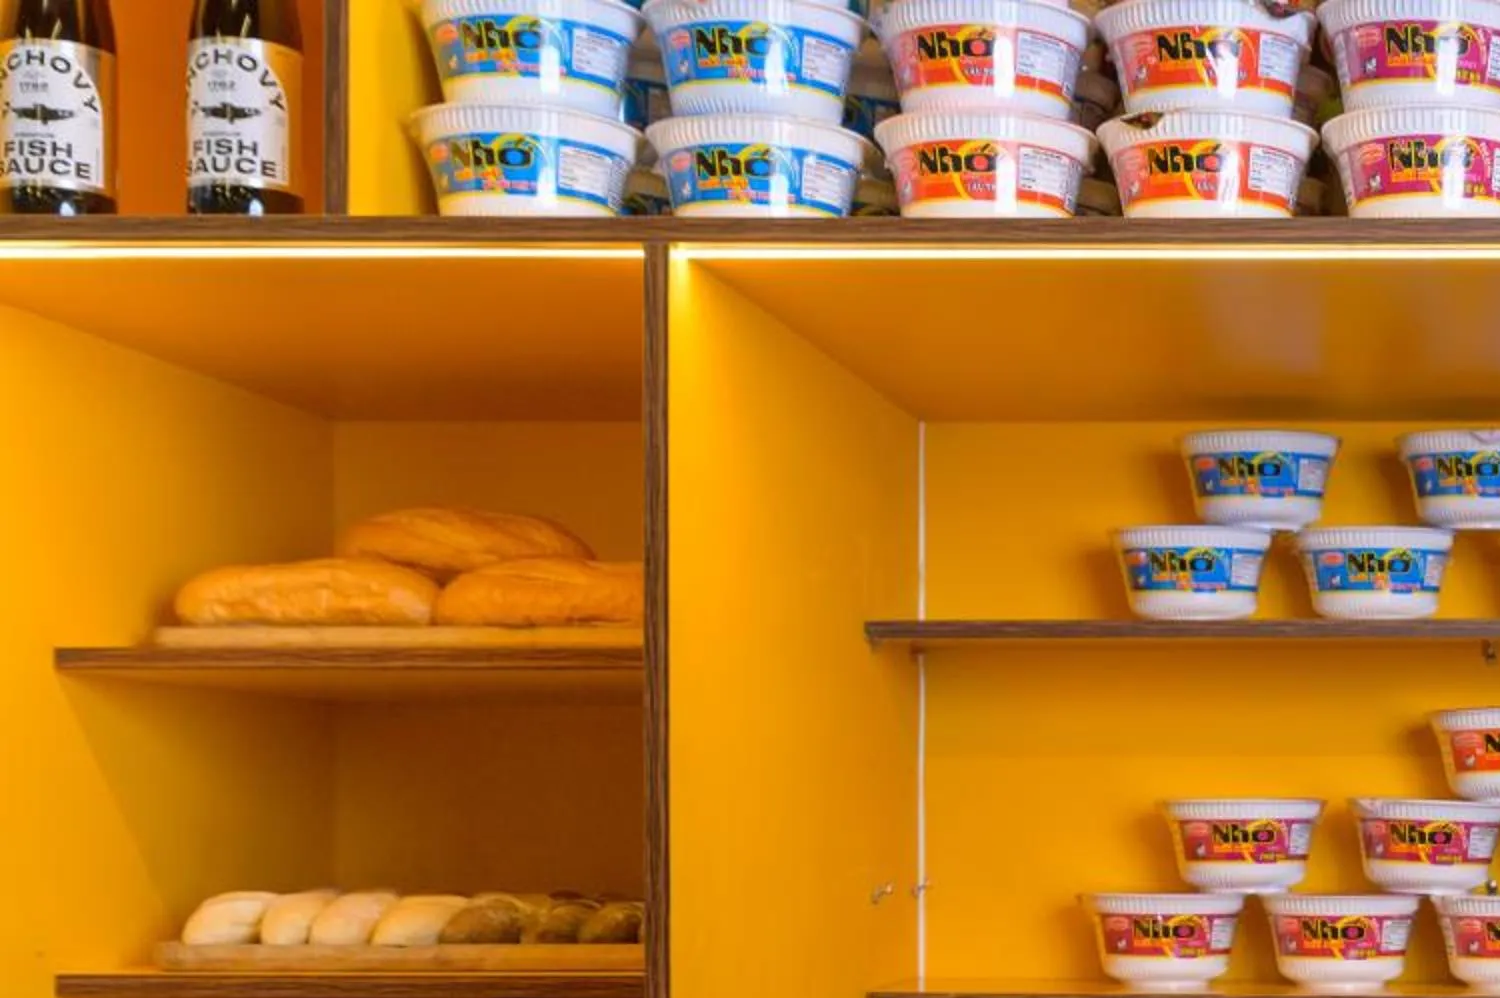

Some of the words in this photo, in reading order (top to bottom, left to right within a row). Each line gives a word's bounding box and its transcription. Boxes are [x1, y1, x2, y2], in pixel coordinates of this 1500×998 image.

[4, 139, 73, 158] FISH
[193, 138, 258, 156] FISH
[0, 157, 91, 180] AUCE
